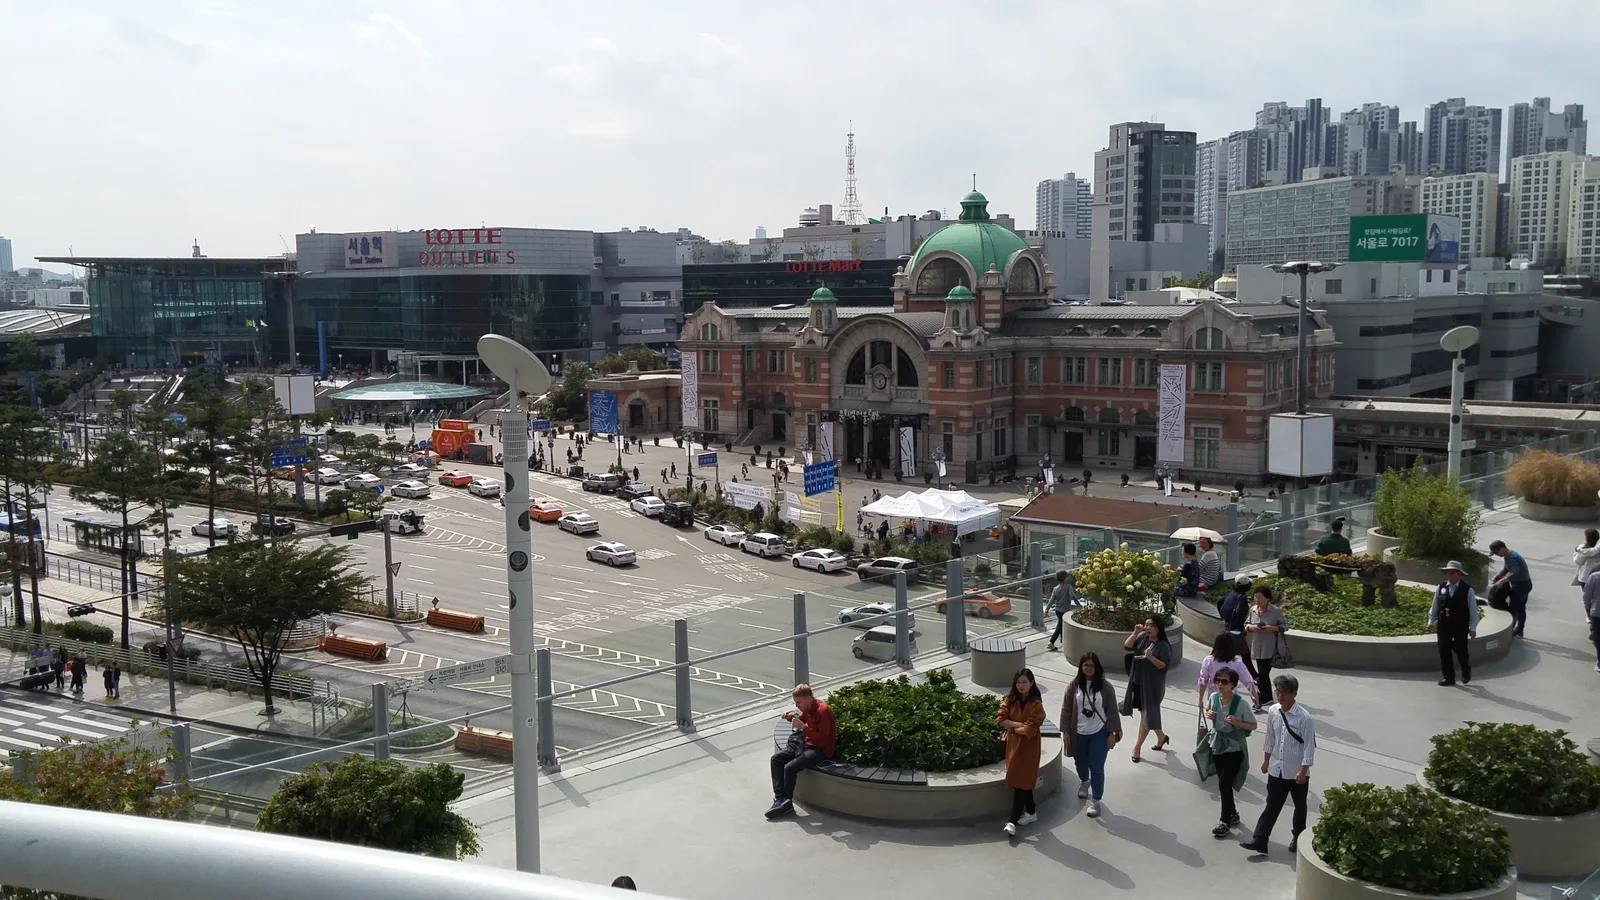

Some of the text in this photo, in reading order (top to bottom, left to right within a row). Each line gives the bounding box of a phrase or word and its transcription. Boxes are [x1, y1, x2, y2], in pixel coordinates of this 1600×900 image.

[425, 228, 502, 245] LOTTE
[1356, 236, 1419, 249] 서울로 7017
[348, 235, 382, 255] 서울역
[348, 255, 383, 264] Seoul Station
[419, 250, 516, 265] OUTLETS
[786, 259, 861, 272] LOTTE Mart
